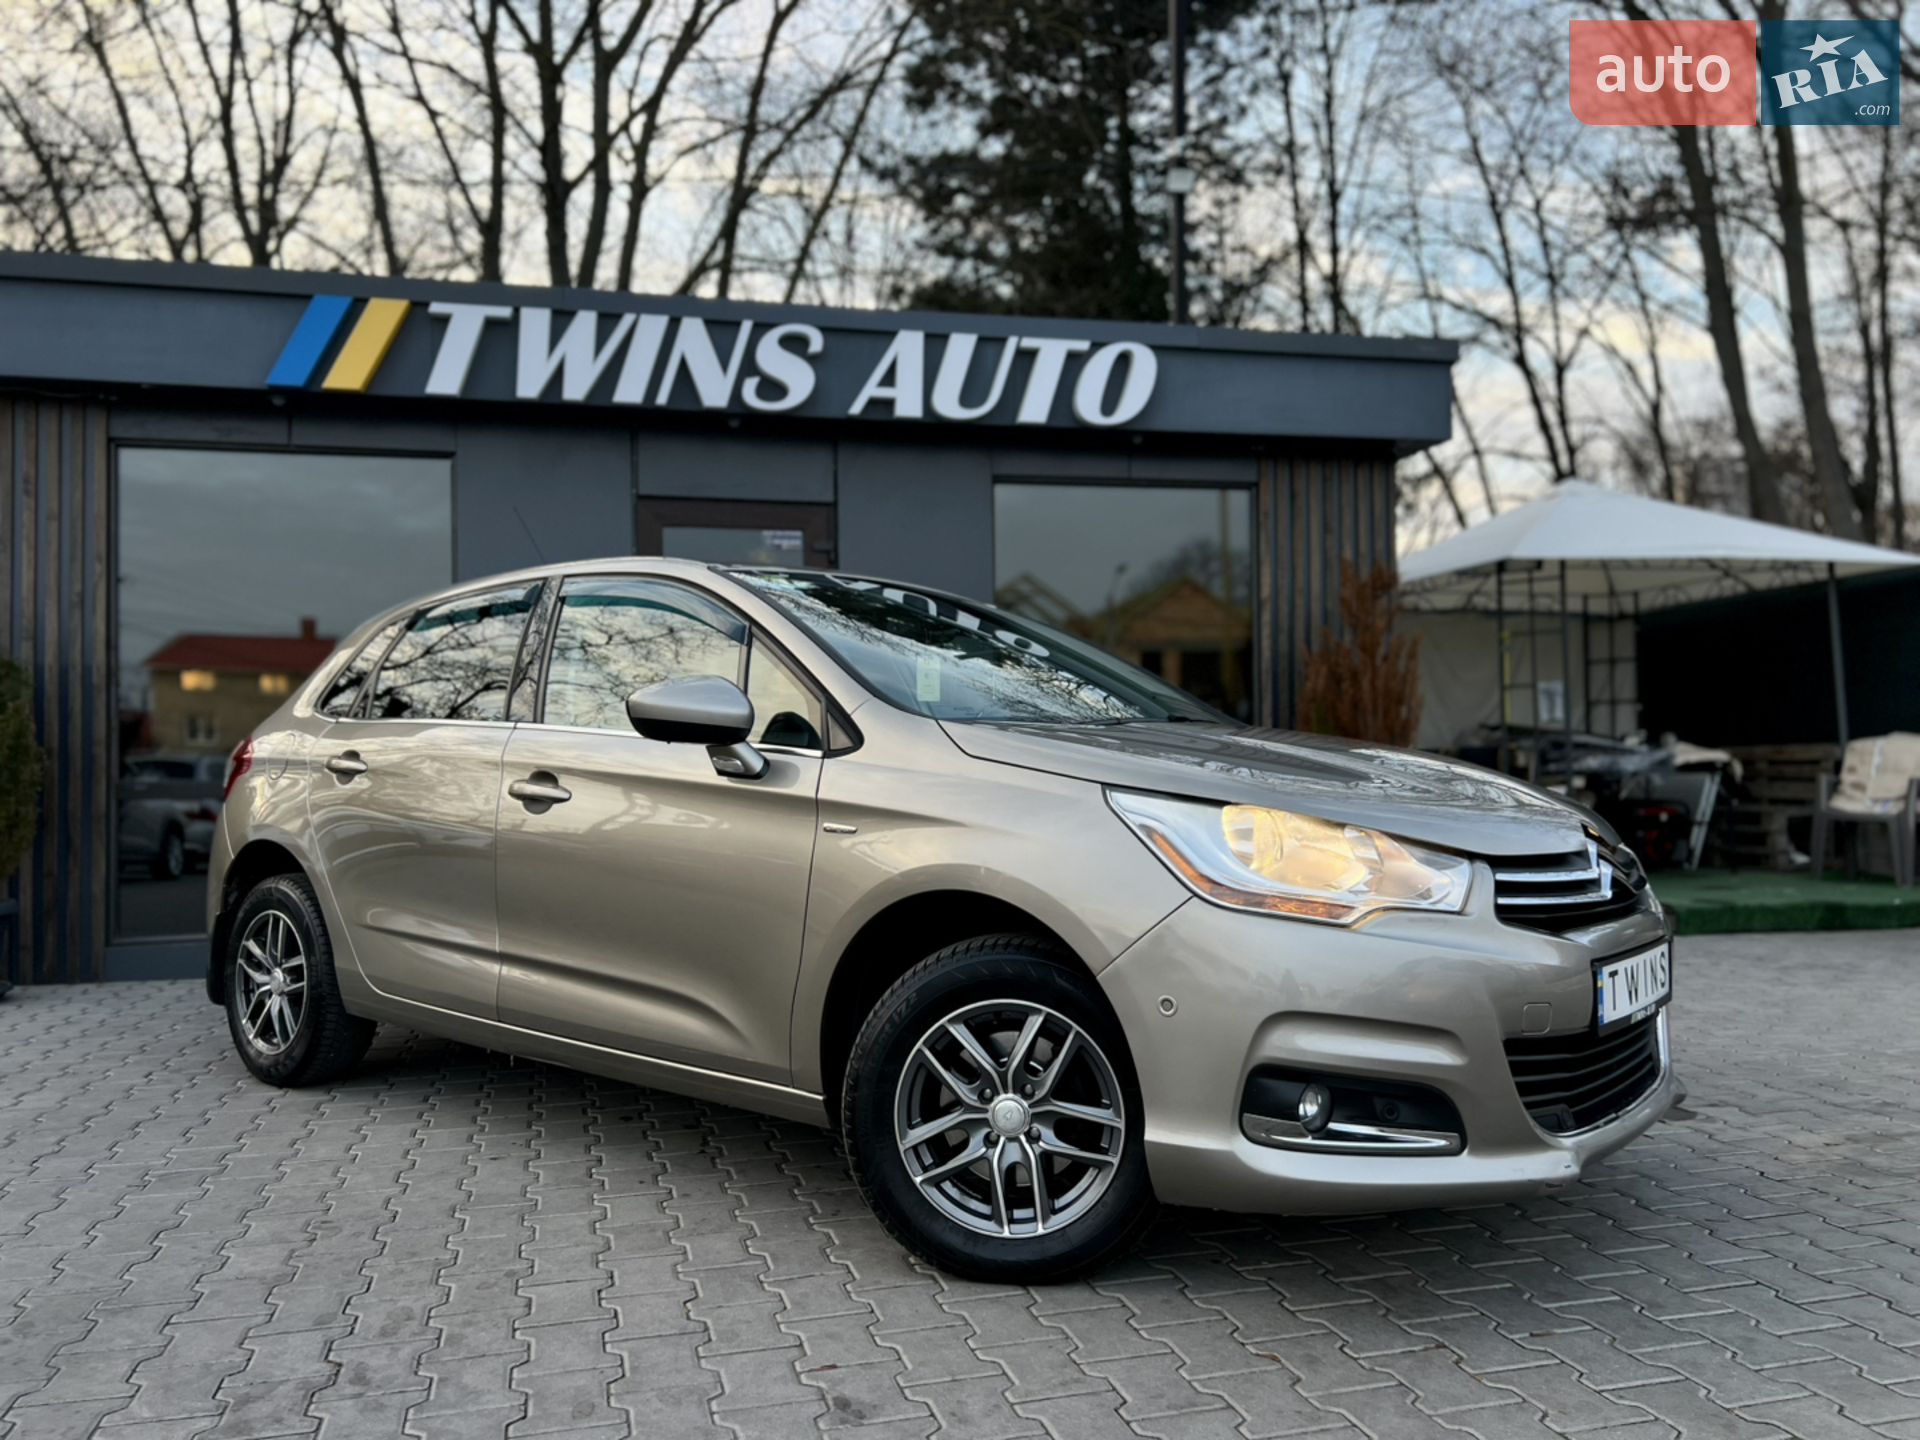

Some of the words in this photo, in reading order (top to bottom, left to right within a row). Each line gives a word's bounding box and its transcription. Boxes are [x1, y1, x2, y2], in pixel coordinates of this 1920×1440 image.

[425, 301, 824, 412] TWINS
[847, 329, 1158, 427] AUTO
[1608, 951, 1667, 1012] TWINS
